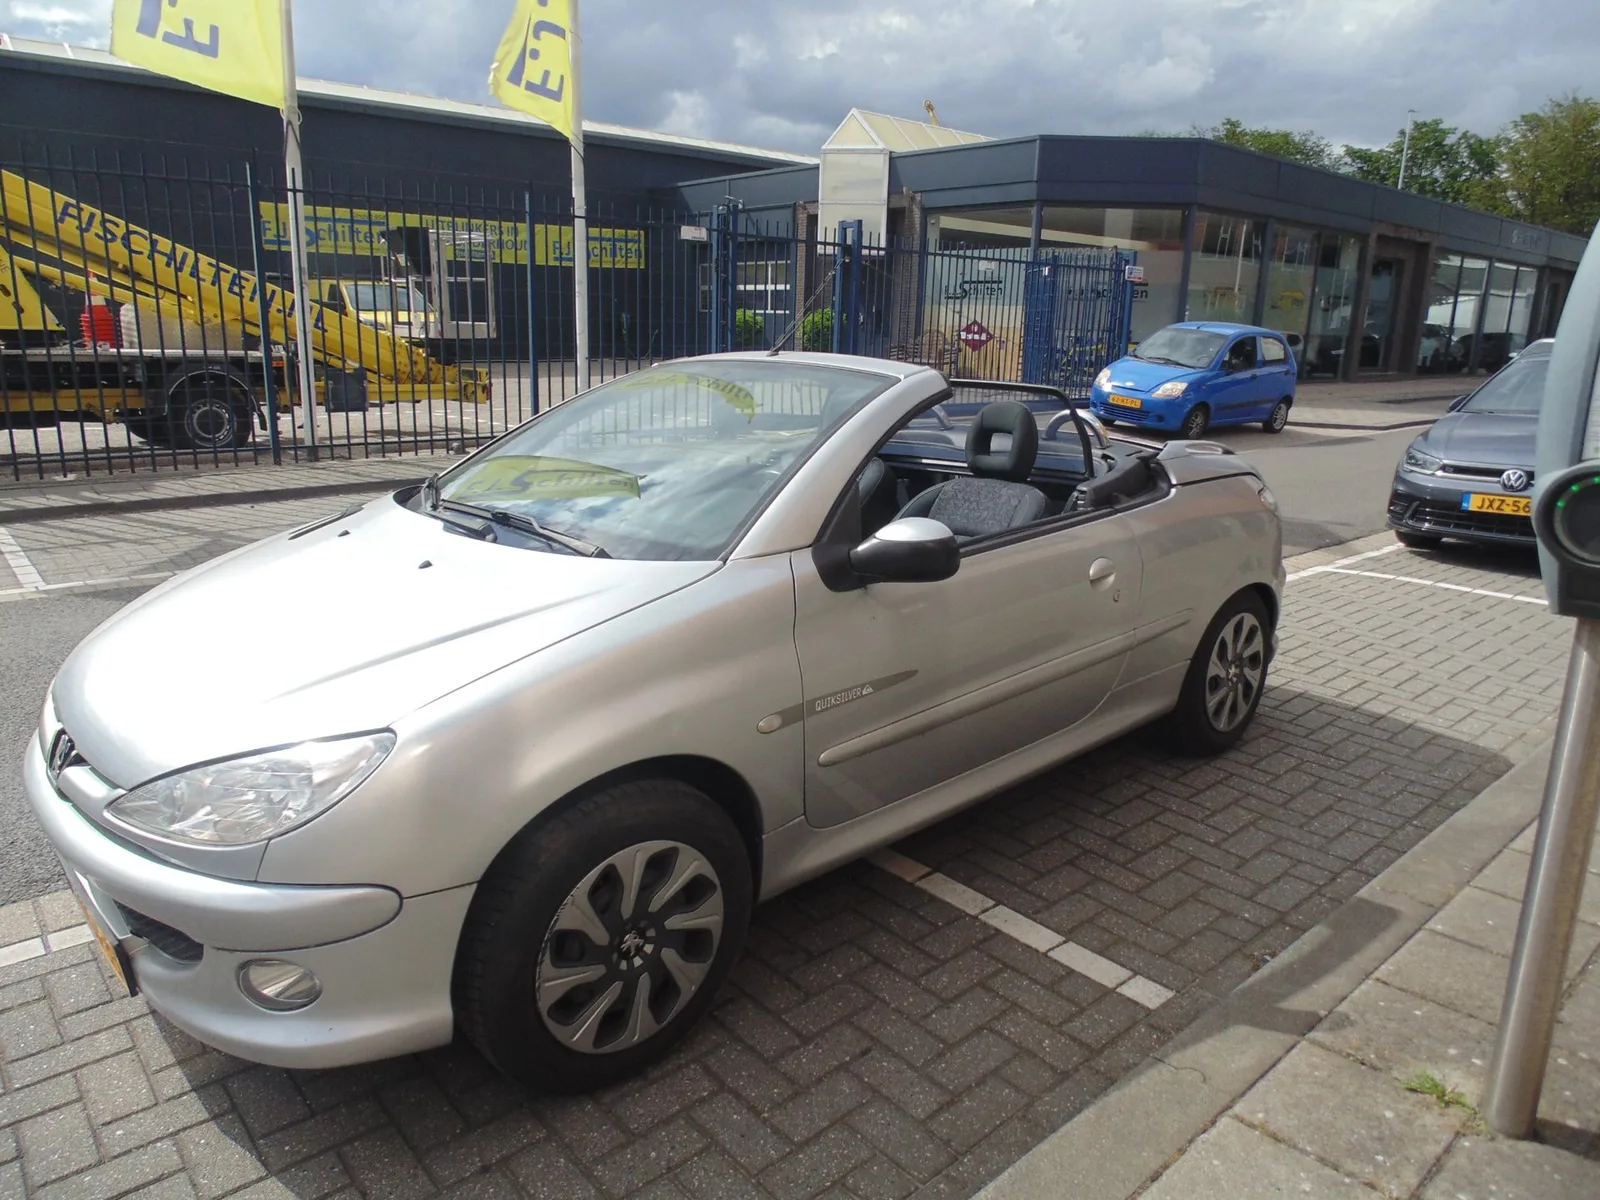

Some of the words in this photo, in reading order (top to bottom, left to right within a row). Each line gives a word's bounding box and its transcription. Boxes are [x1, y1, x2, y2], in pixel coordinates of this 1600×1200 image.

[426, 219, 503, 235] UTBLINKERS
[1477, 497, 1531, 515] JXZ-56
[815, 687, 862, 712] QUIKSILVER
